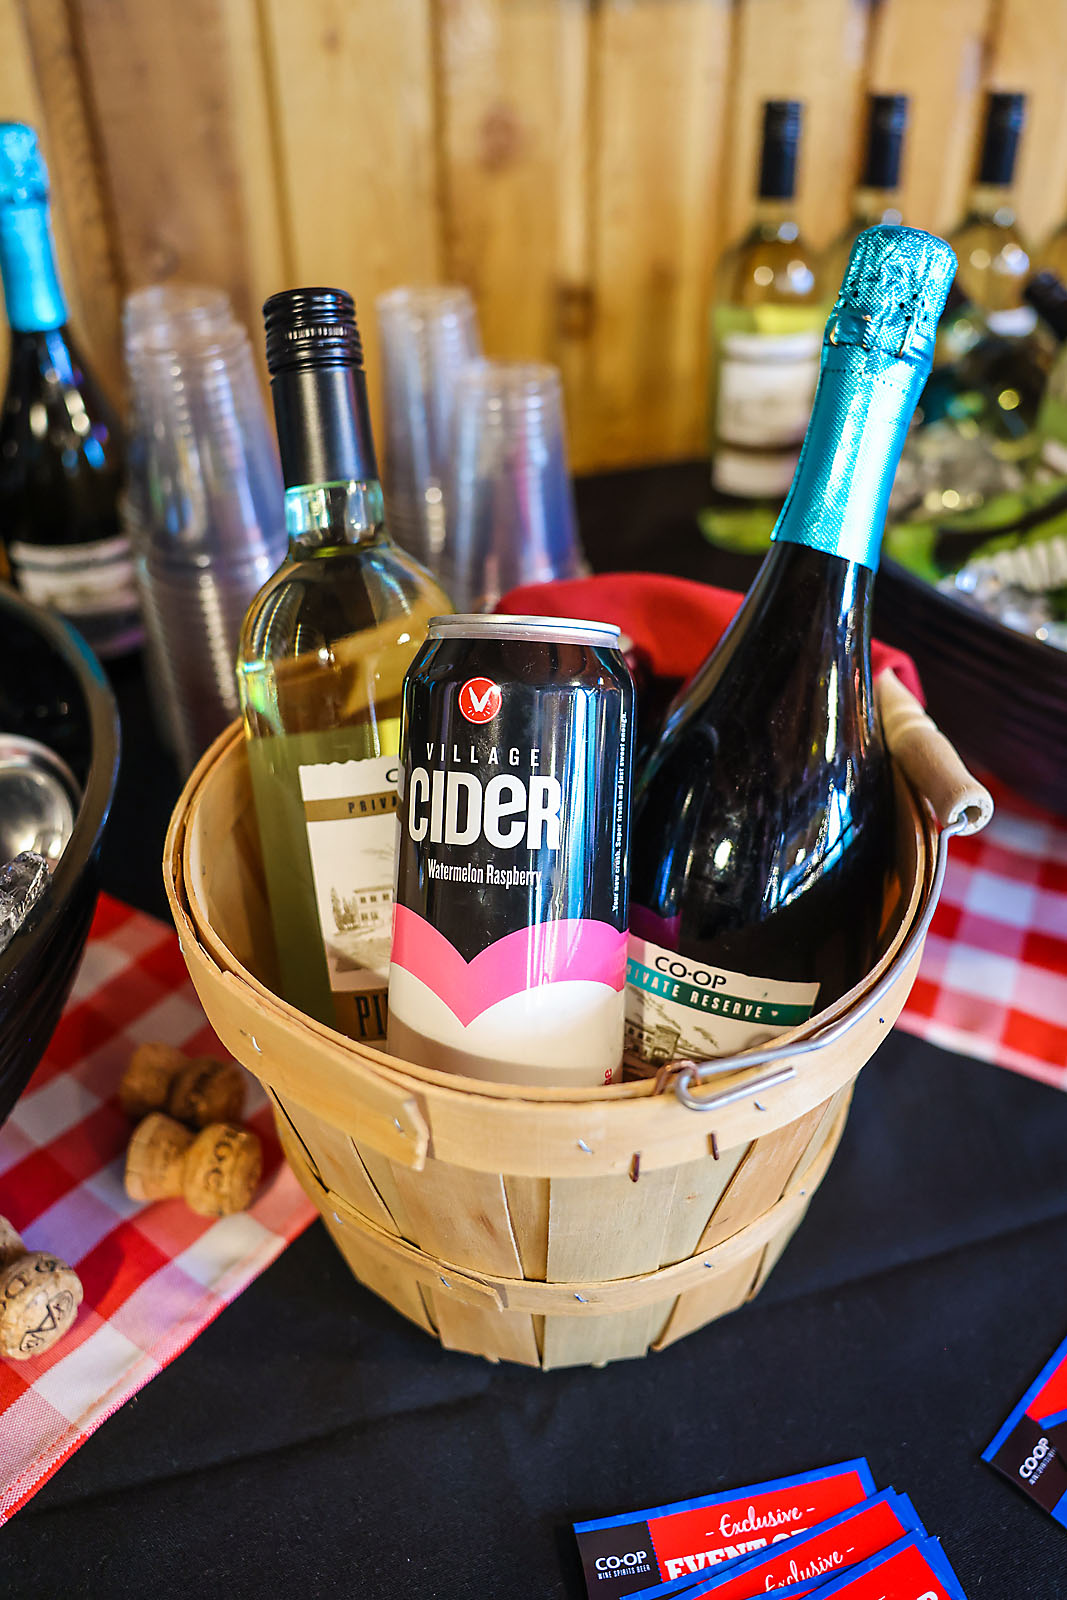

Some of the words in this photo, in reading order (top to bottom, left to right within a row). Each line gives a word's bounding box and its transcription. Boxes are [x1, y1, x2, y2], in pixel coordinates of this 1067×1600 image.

[426, 742, 541, 767] VILLAGE
[615, 823, 623, 848] Super
[427, 858, 484, 884] Watermelon
[486, 864, 543, 890] Raspberry
[354, 994, 388, 1037] PI
[690, 990, 764, 1019] RESERVE
[718, 1505, 803, 1538] Exclusive
[613, 1566, 636, 1578] SPIRITS
